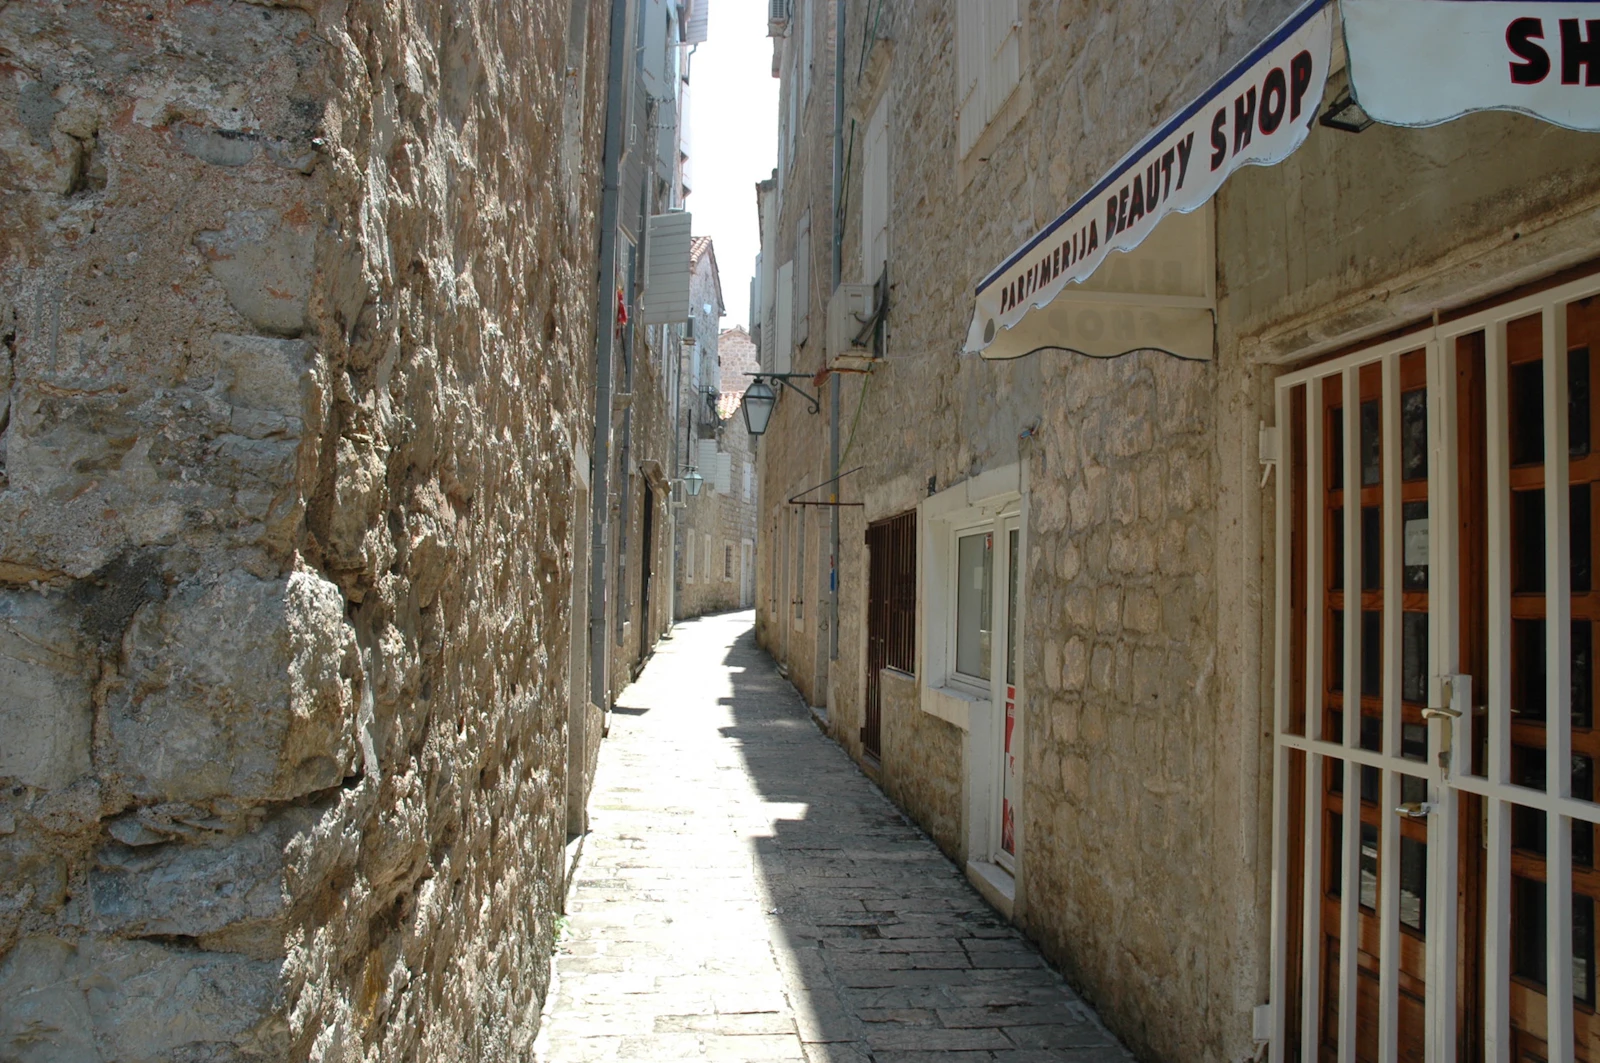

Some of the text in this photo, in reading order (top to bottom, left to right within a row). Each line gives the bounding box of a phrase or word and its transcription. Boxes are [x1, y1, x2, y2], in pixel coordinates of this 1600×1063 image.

[1000, 49, 1313, 315] PARFIMERIJA BEAUTY SHOP
